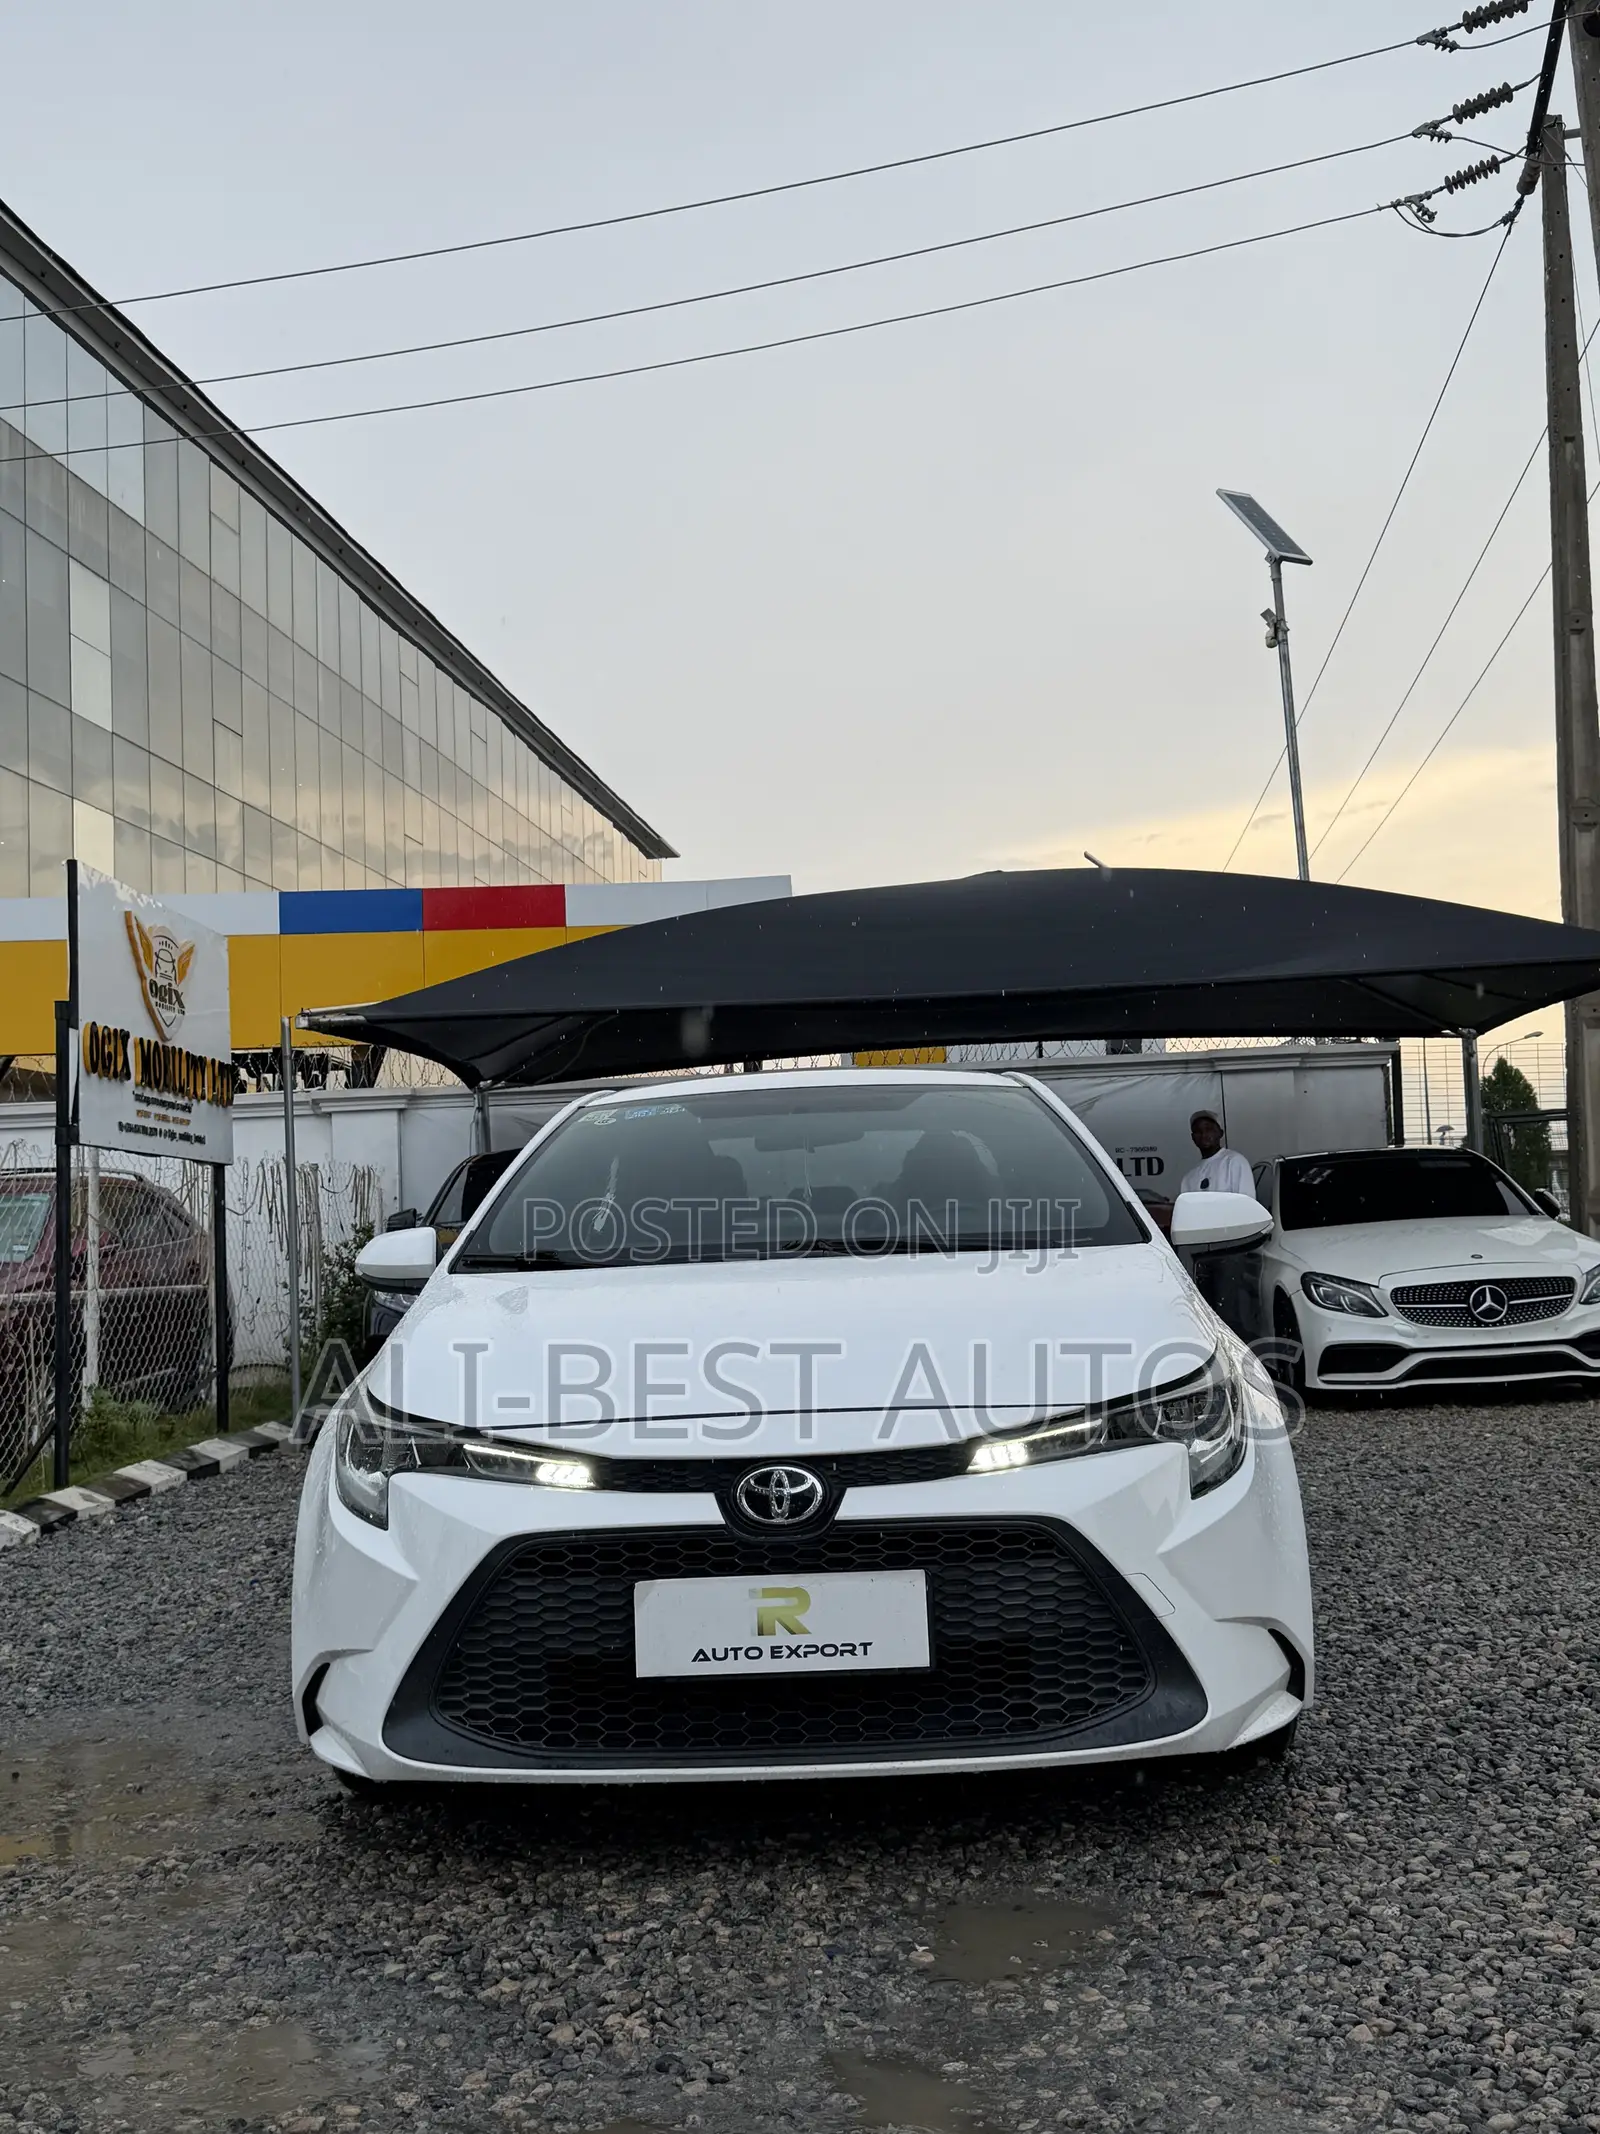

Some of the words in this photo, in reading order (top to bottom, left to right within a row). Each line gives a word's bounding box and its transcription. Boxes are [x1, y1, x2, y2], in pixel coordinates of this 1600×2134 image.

[83, 1021, 131, 1081] OGIX
[134, 1037, 207, 1101] MOBILITY
[1116, 1156, 1164, 1176] LTD
[691, 1646, 764, 1663] AUTO
[770, 1641, 873, 1660] EXPORT
